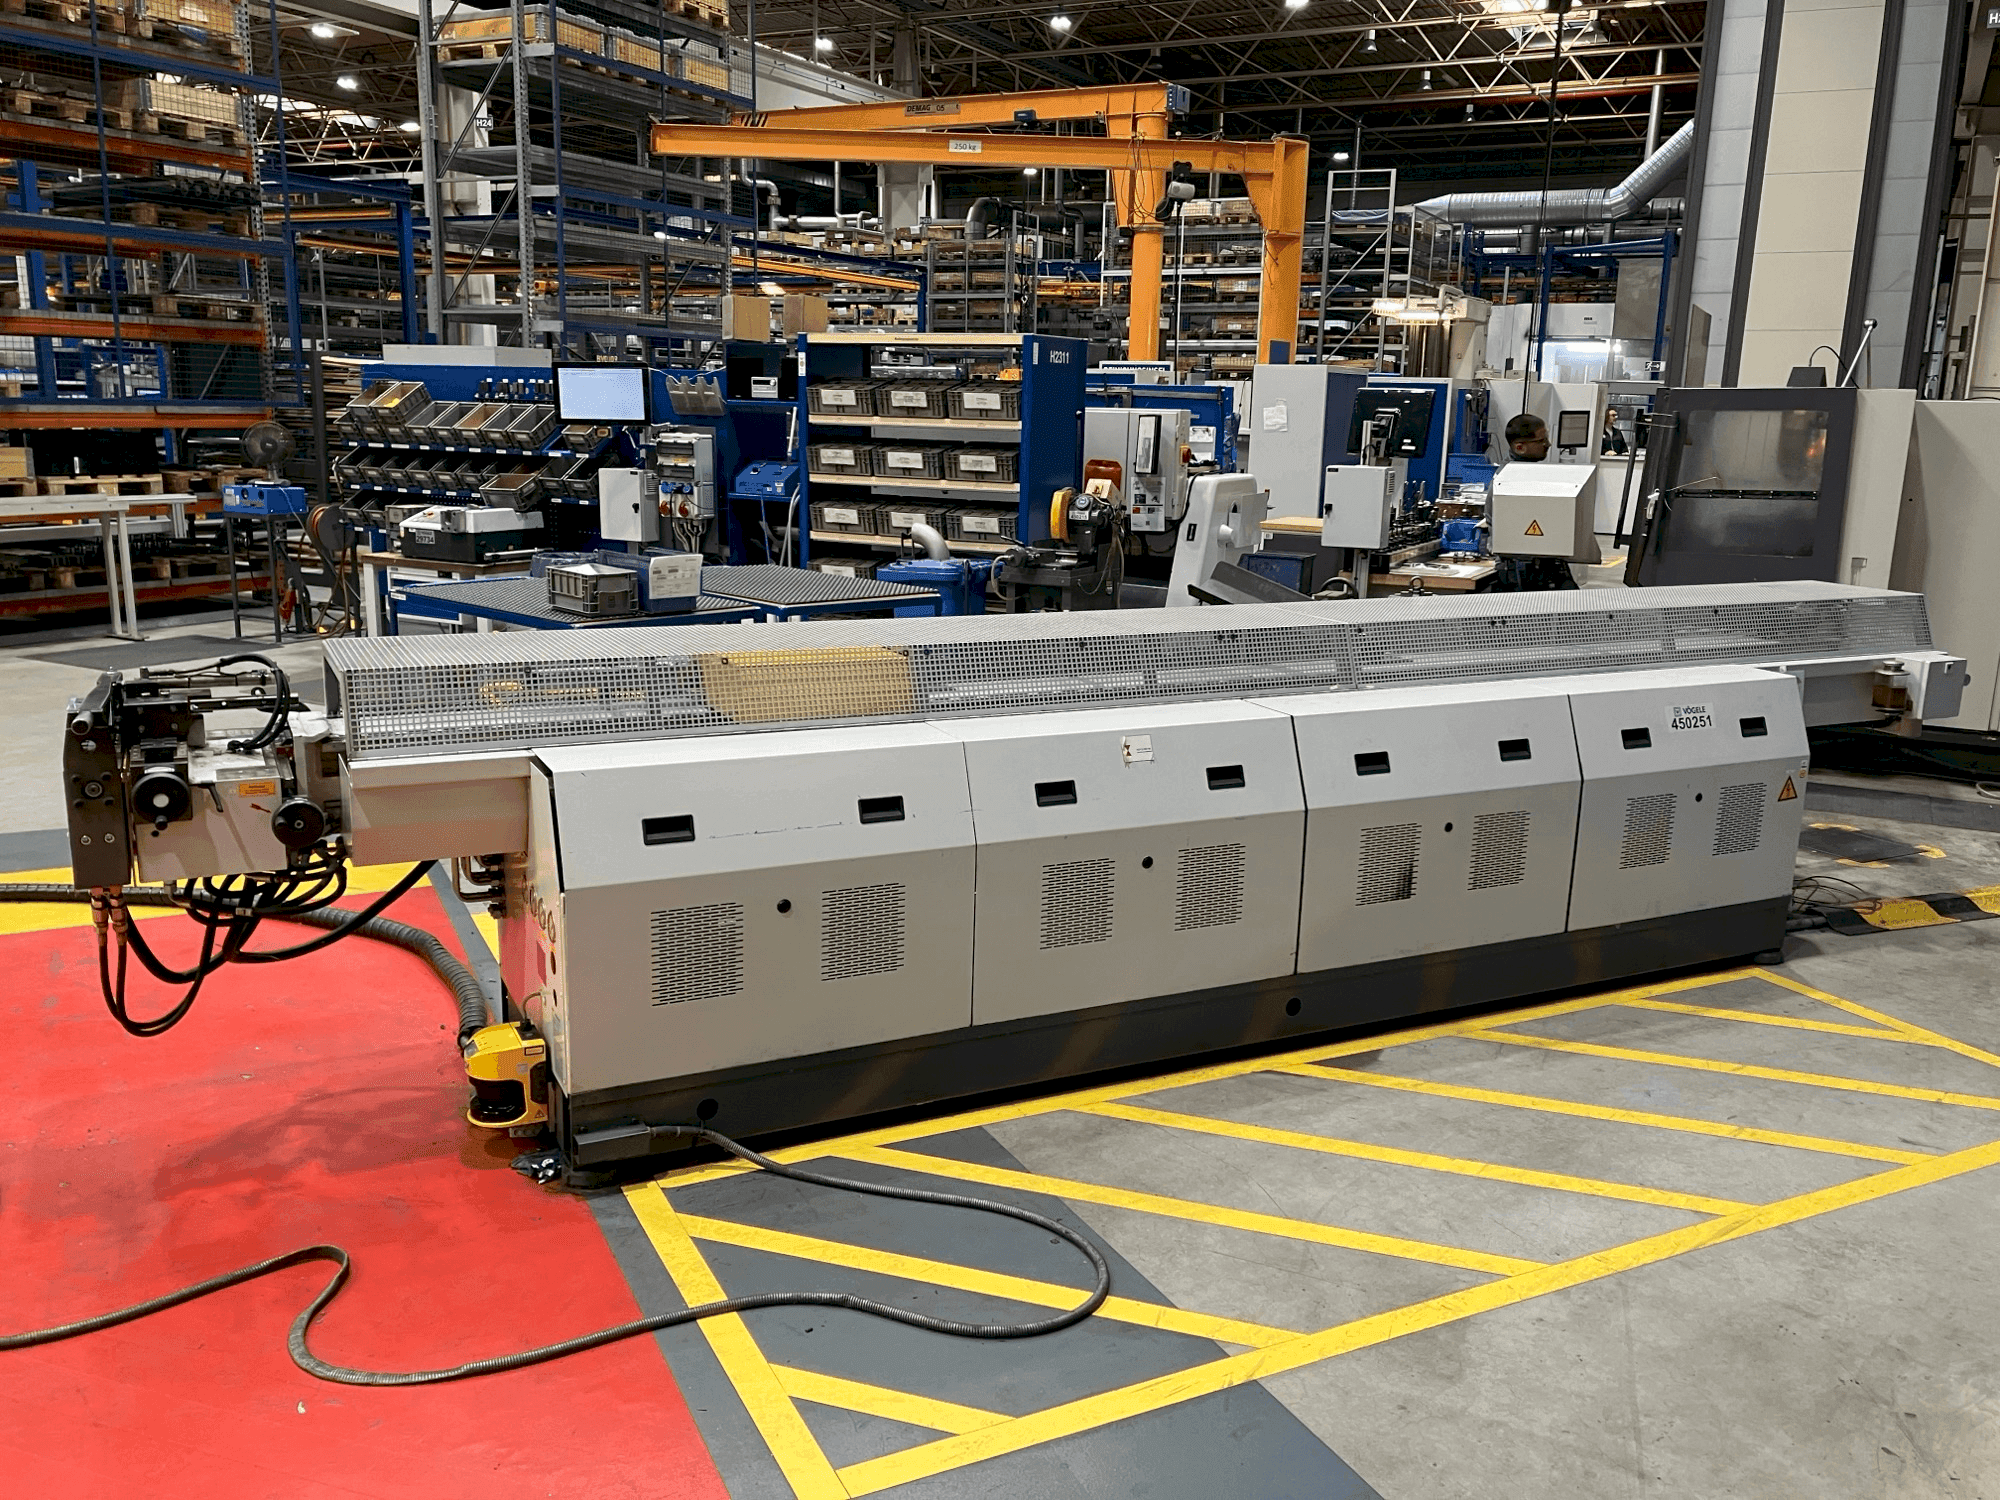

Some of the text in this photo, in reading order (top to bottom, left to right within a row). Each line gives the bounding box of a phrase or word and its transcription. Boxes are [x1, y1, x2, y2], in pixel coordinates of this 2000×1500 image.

[907, 104, 932, 112] DEMAG
[476, 119, 492, 127] H24
[954, 143, 977, 152] 250 kg
[1050, 349, 1070, 364] H2311
[1682, 705, 1707, 715] VÖGELE
[1671, 714, 1713, 730] 450251
